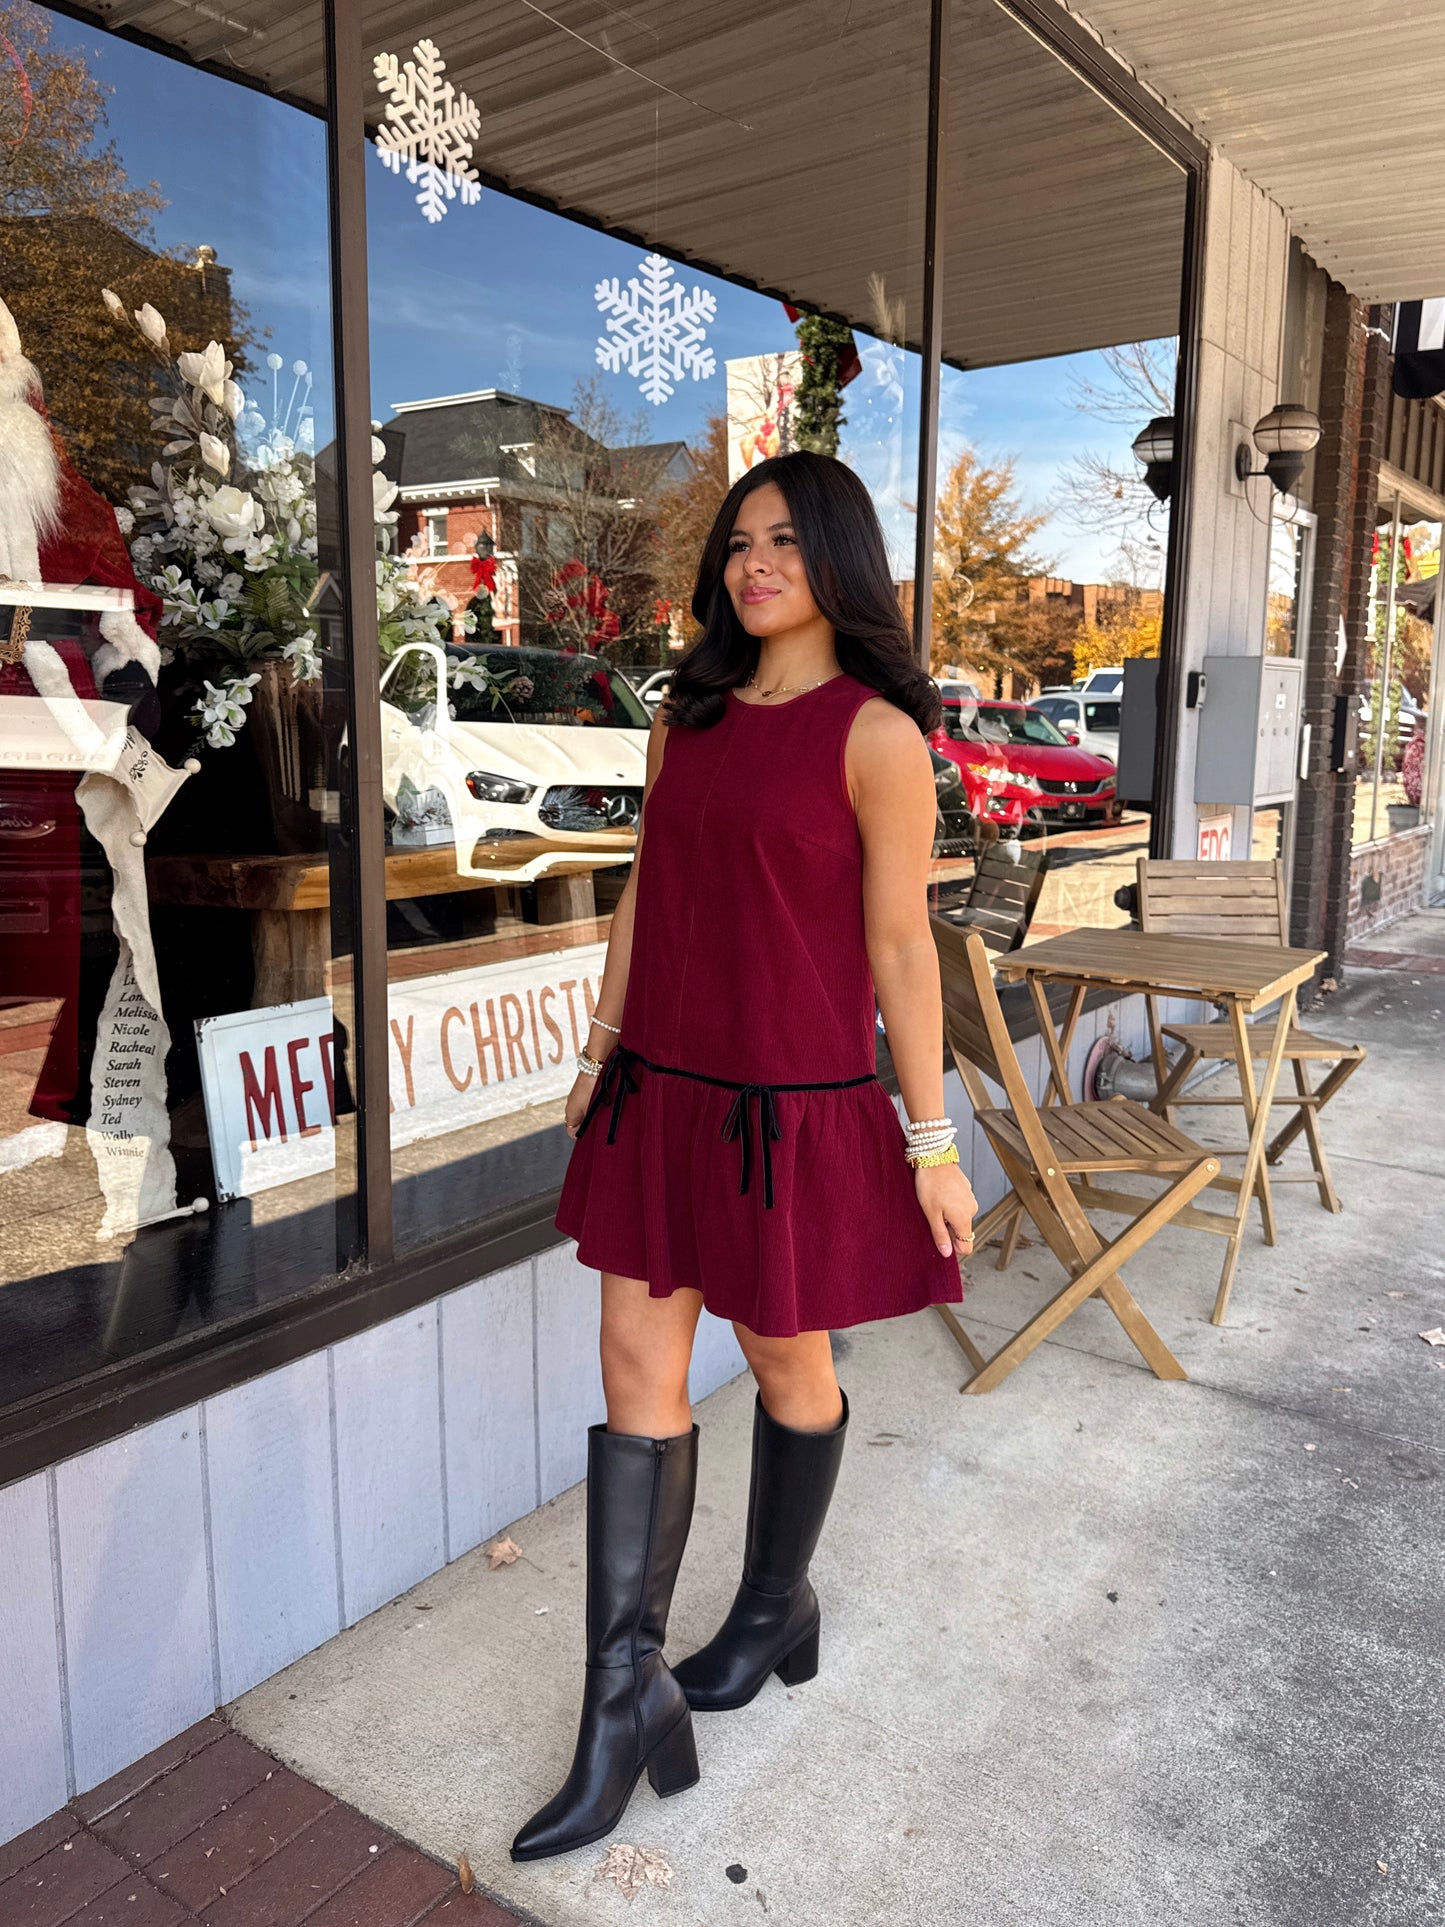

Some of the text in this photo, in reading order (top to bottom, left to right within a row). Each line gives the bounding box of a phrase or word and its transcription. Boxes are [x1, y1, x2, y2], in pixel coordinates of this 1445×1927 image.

[119, 992, 145, 1003] Lon
[113, 1006, 159, 1021] Melissa
[111, 1022, 150, 1036] Nicole
[109, 1041, 156, 1056] Racheal
[106, 1058, 141, 1071] Sarah
[103, 1077, 141, 1088] Steven
[102, 1094, 143, 1110] Sydney
[101, 1112, 122, 1125] Ted
[101, 1130, 134, 1144] Wally
[105, 1146, 144, 1158] Winnie
